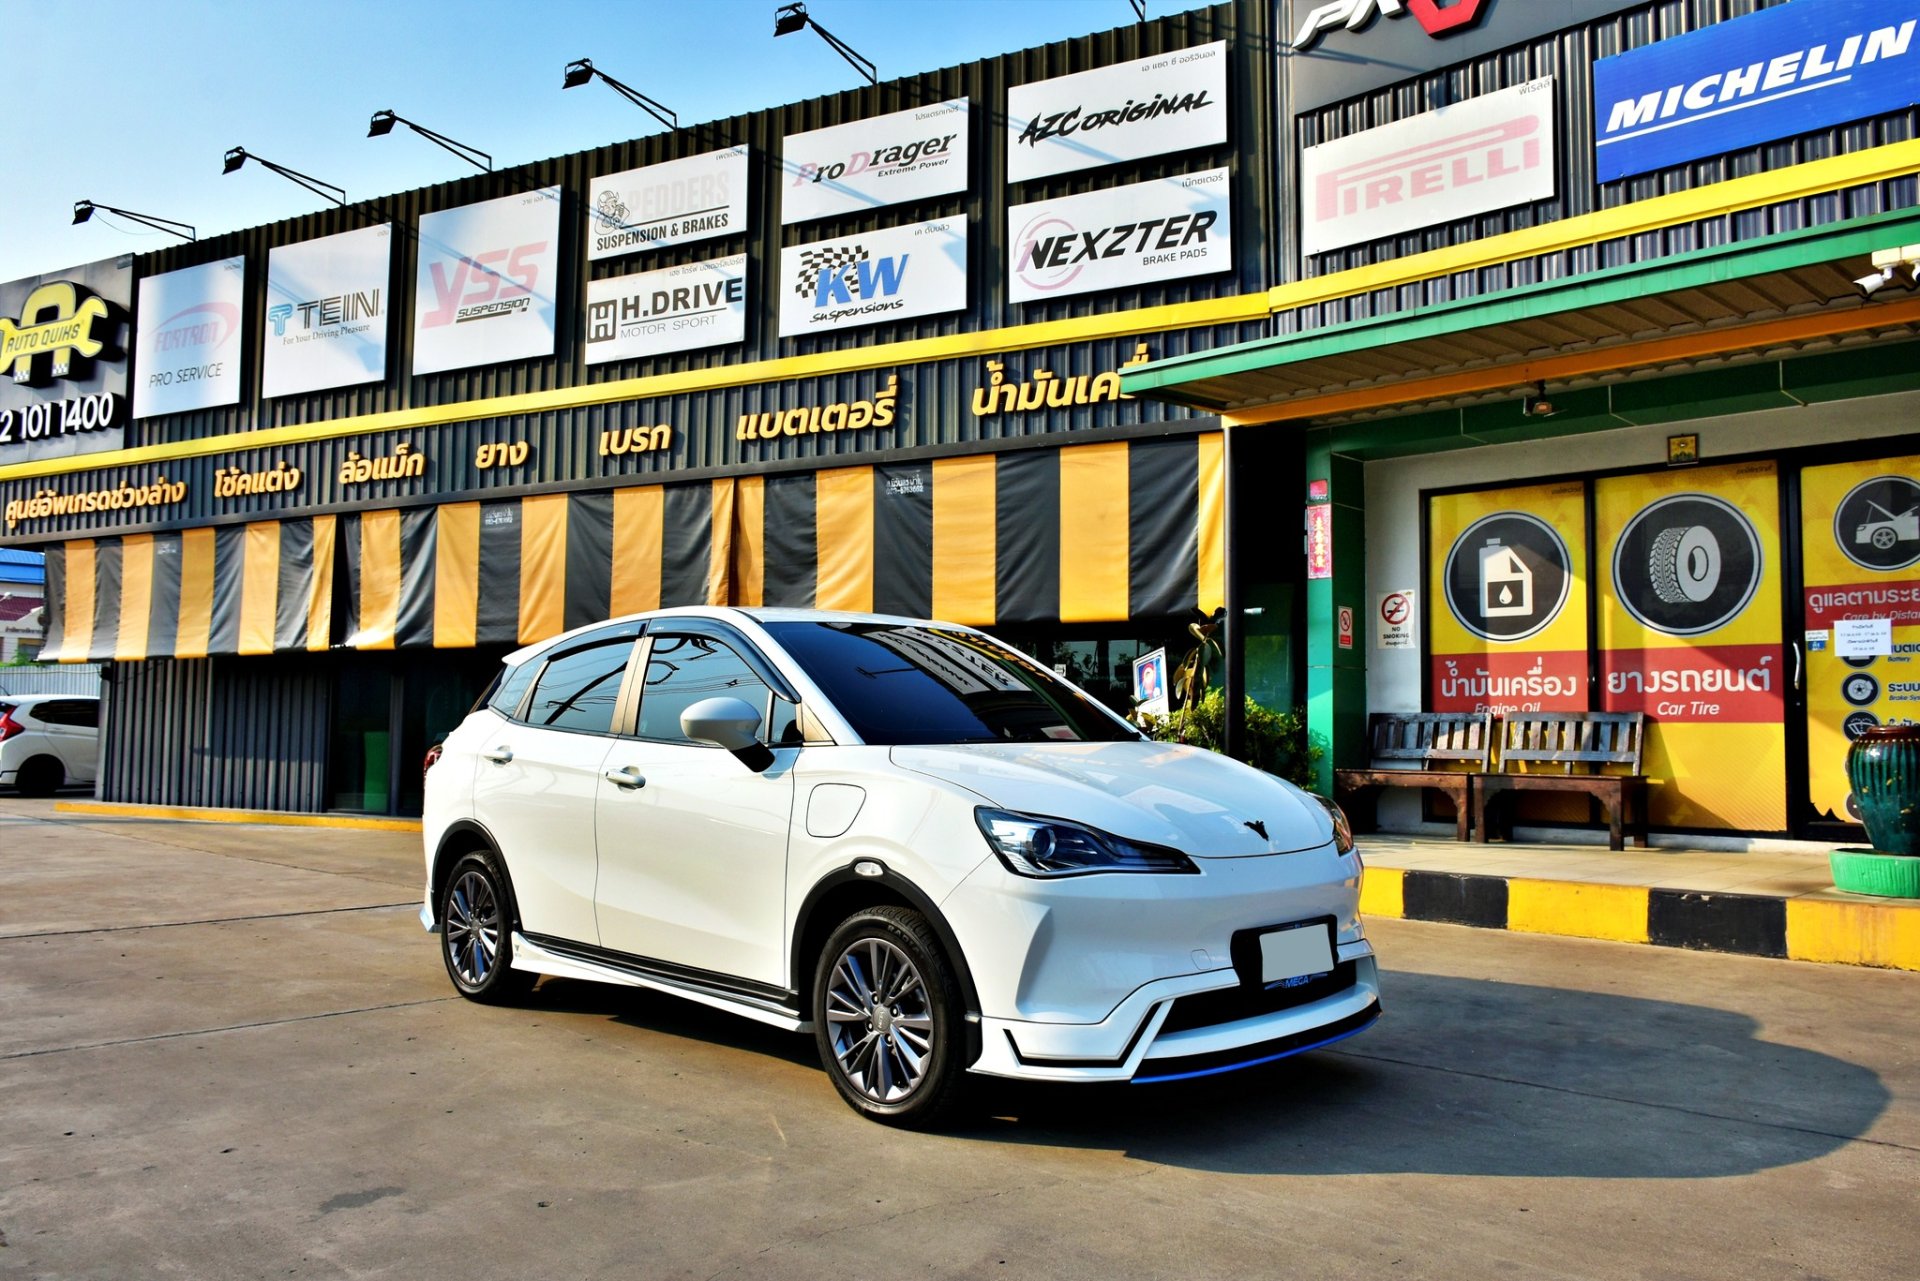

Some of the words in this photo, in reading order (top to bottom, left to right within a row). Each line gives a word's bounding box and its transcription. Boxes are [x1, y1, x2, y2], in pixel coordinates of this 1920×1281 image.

[1605, 19, 1918, 133] MICHELIN
[1018, 105, 1082, 148] AZC
[792, 133, 957, 187] ProDrager
[877, 166, 916, 178] Extreme
[919, 158, 949, 171] Power
[1315, 114, 1540, 222] PIRELLI
[626, 170, 730, 221] PEDDERS
[596, 225, 667, 251] SUSPENSION
[670, 222, 679, 236] &
[682, 213, 729, 235] BRAKES
[1016, 210, 1218, 273] NEXZTER
[1143, 252, 1177, 266] BRAKE
[1180, 247, 1208, 261] PADS
[420, 241, 548, 329] YSS
[621, 277, 743, 320] H.DRIVE
[814, 253, 910, 308] KW
[297, 288, 380, 329] TEIN
[457, 297, 530, 318] SUSPENSION
[620, 324, 667, 340] MOTOR
[672, 314, 717, 331] SPORT
[809, 299, 904, 323] suspensions
[6, 333, 38, 353] AUTO
[283, 337, 295, 345] For
[295, 333, 311, 344] Your
[312, 329, 340, 341] Driving
[340, 324, 370, 336] Pleasure
[149, 371, 173, 388] PRO
[175, 362, 223, 383] SERVICE
[20, 402, 52, 440] 101
[59, 391, 114, 434] 1400
[5, 476, 186, 529] ศูนย์อัพเกรดช่วงล่าง
[214, 460, 300, 498] โช้คแต่ง
[338, 442, 425, 485] ล้อแม็ก
[474, 440, 529, 469] ยาง
[599, 424, 671, 456] เบรก
[736, 374, 898, 441] แบตเตอรี่
[1382, 632, 1410, 640] SMOKING
[1441, 656, 1577, 697] น้ำมันเครื่อง
[1607, 655, 1772, 694] ยางรถยนต์
[1521, 702, 1541, 713] Oil
[1657, 701, 1685, 716] Car
[1690, 701, 1721, 716] Tire
